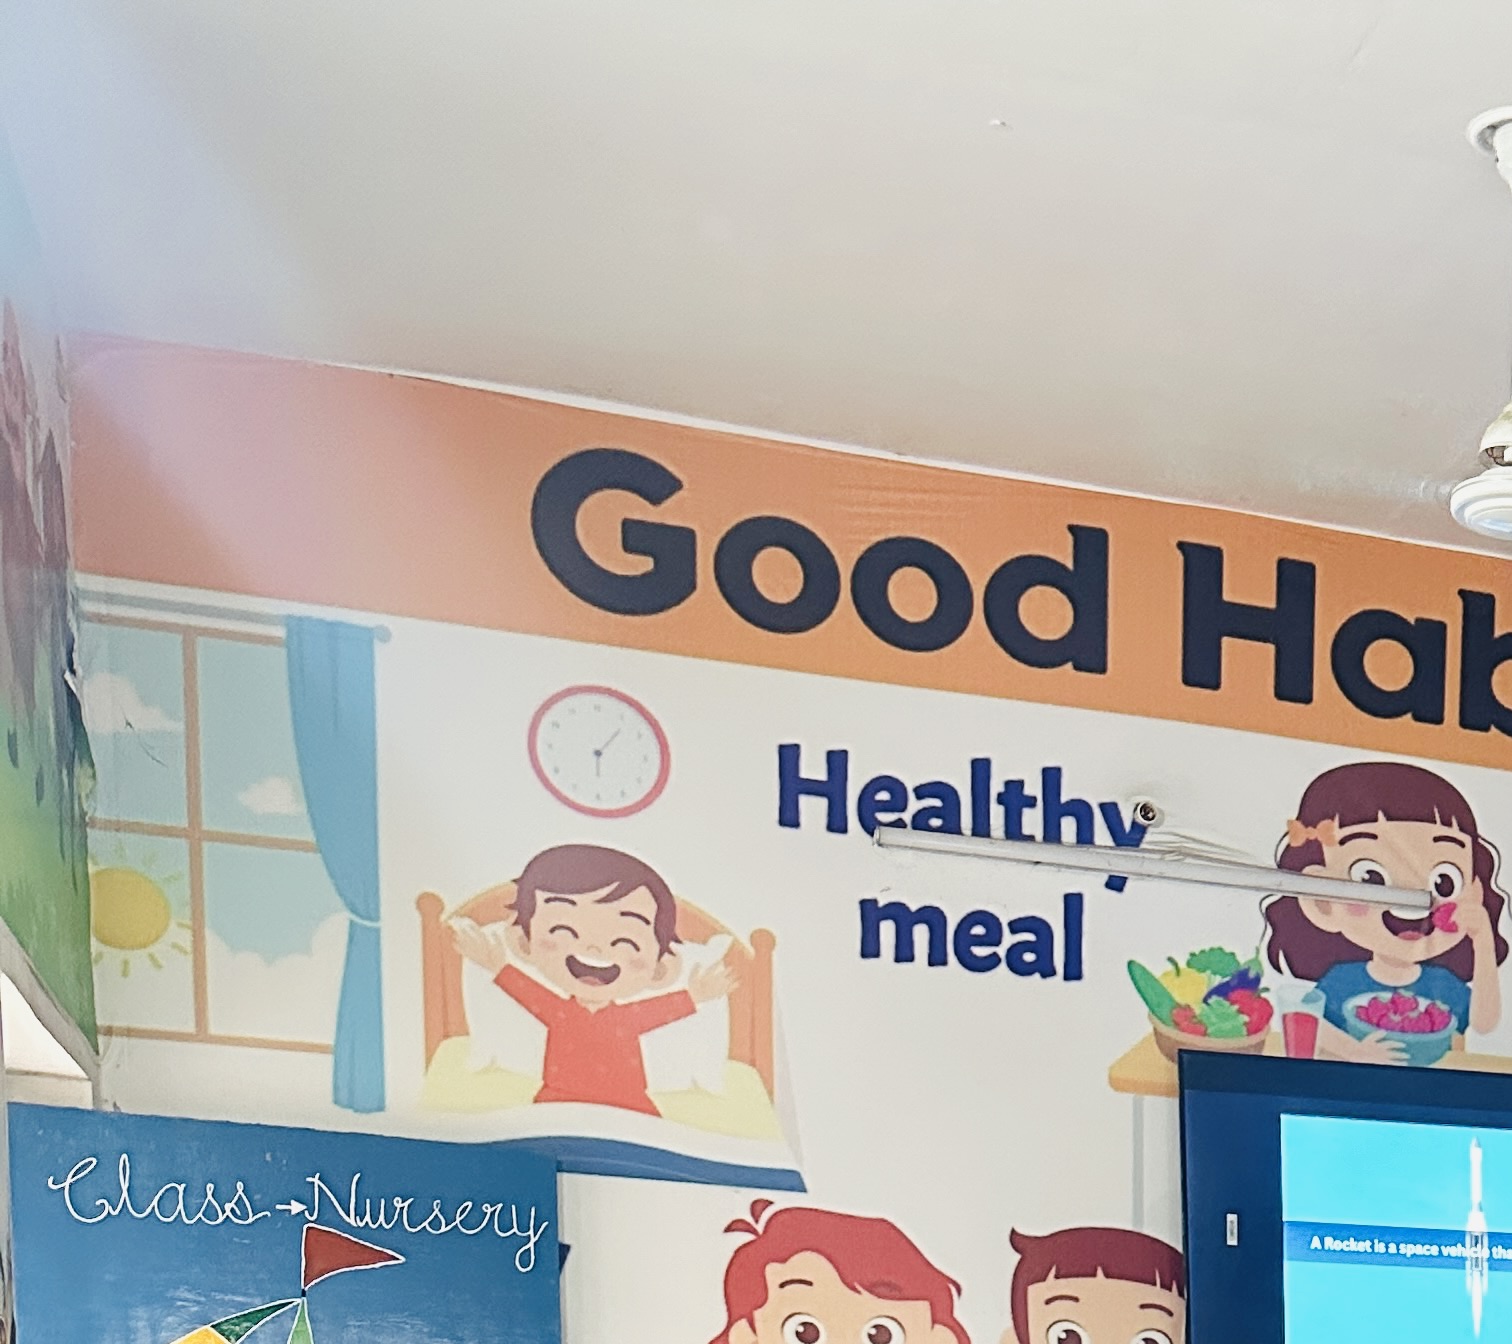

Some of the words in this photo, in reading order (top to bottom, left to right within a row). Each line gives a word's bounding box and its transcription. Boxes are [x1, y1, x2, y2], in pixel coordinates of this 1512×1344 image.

[531, 448, 1108, 674] Good
[777, 743, 1148, 892] Healthy
[860, 893, 1084, 981] meal
[48, 1153, 270, 1225] Class
[304, 1172, 549, 1272] Nursery
[1309, 1235, 1323, 1250] A
[1323, 1236, 1373, 1253] Rocket
[1373, 1238, 1387, 1253] is
[1388, 1243, 1398, 1254] a
[1399, 1242, 1440, 1258] space
